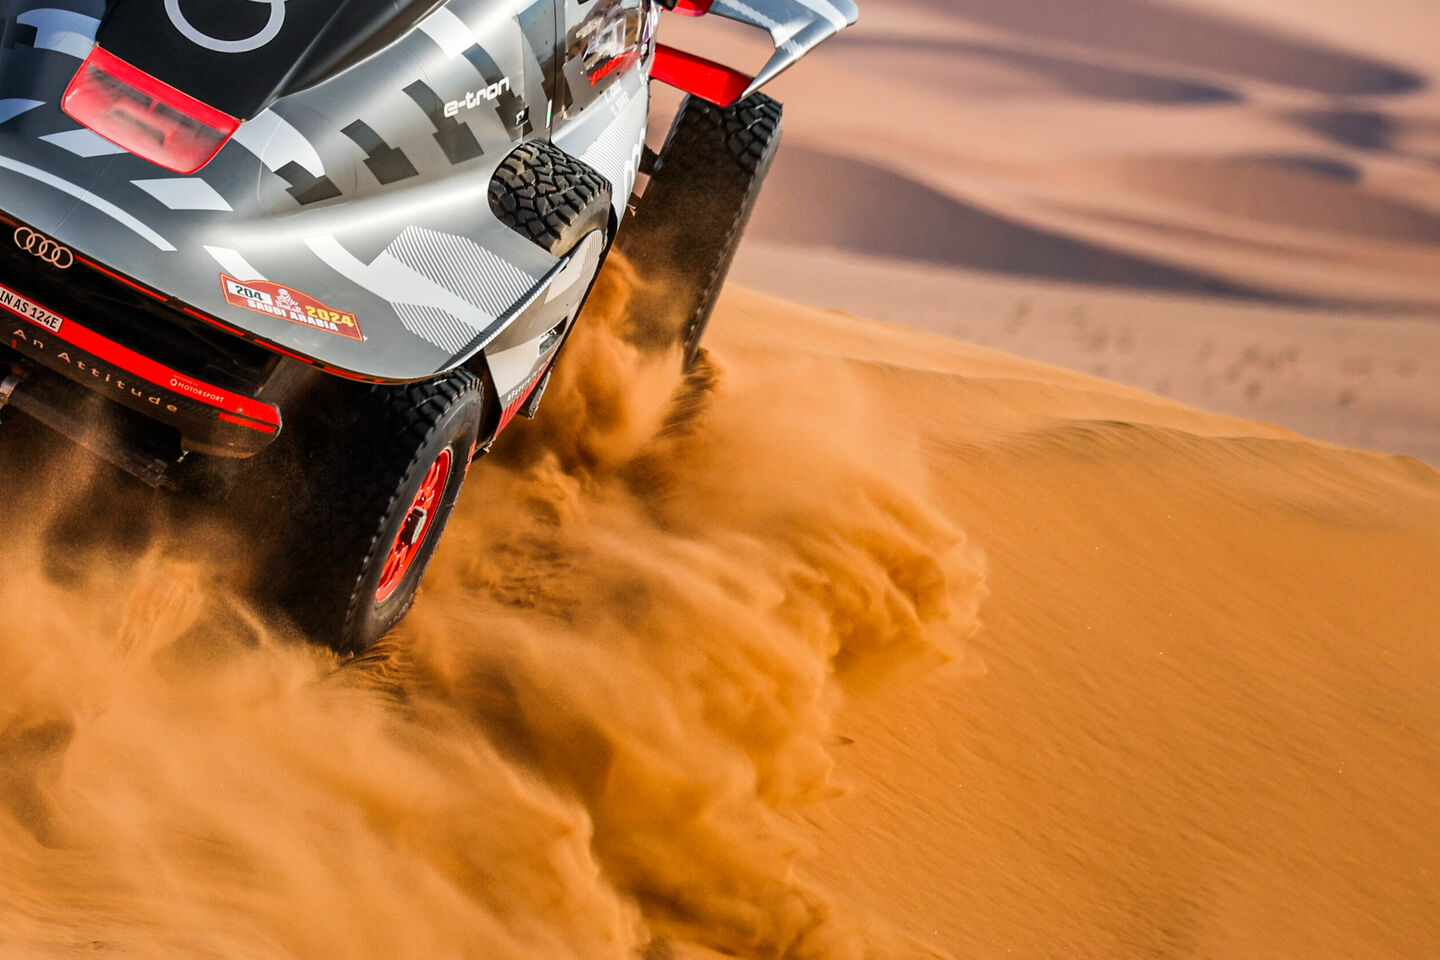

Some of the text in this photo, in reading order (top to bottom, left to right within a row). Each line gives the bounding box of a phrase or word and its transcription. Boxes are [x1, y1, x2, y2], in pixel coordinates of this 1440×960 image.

[443, 76, 510, 118] e-tron
[234, 284, 264, 301] 204
[13, 298, 29, 313] AS
[29, 307, 59, 329] 124E
[246, 298, 339, 332] SAUDI ARABIA
[305, 305, 355, 327] 2024
[13, 329, 44, 349] An
[57, 352, 178, 412] Attitude
